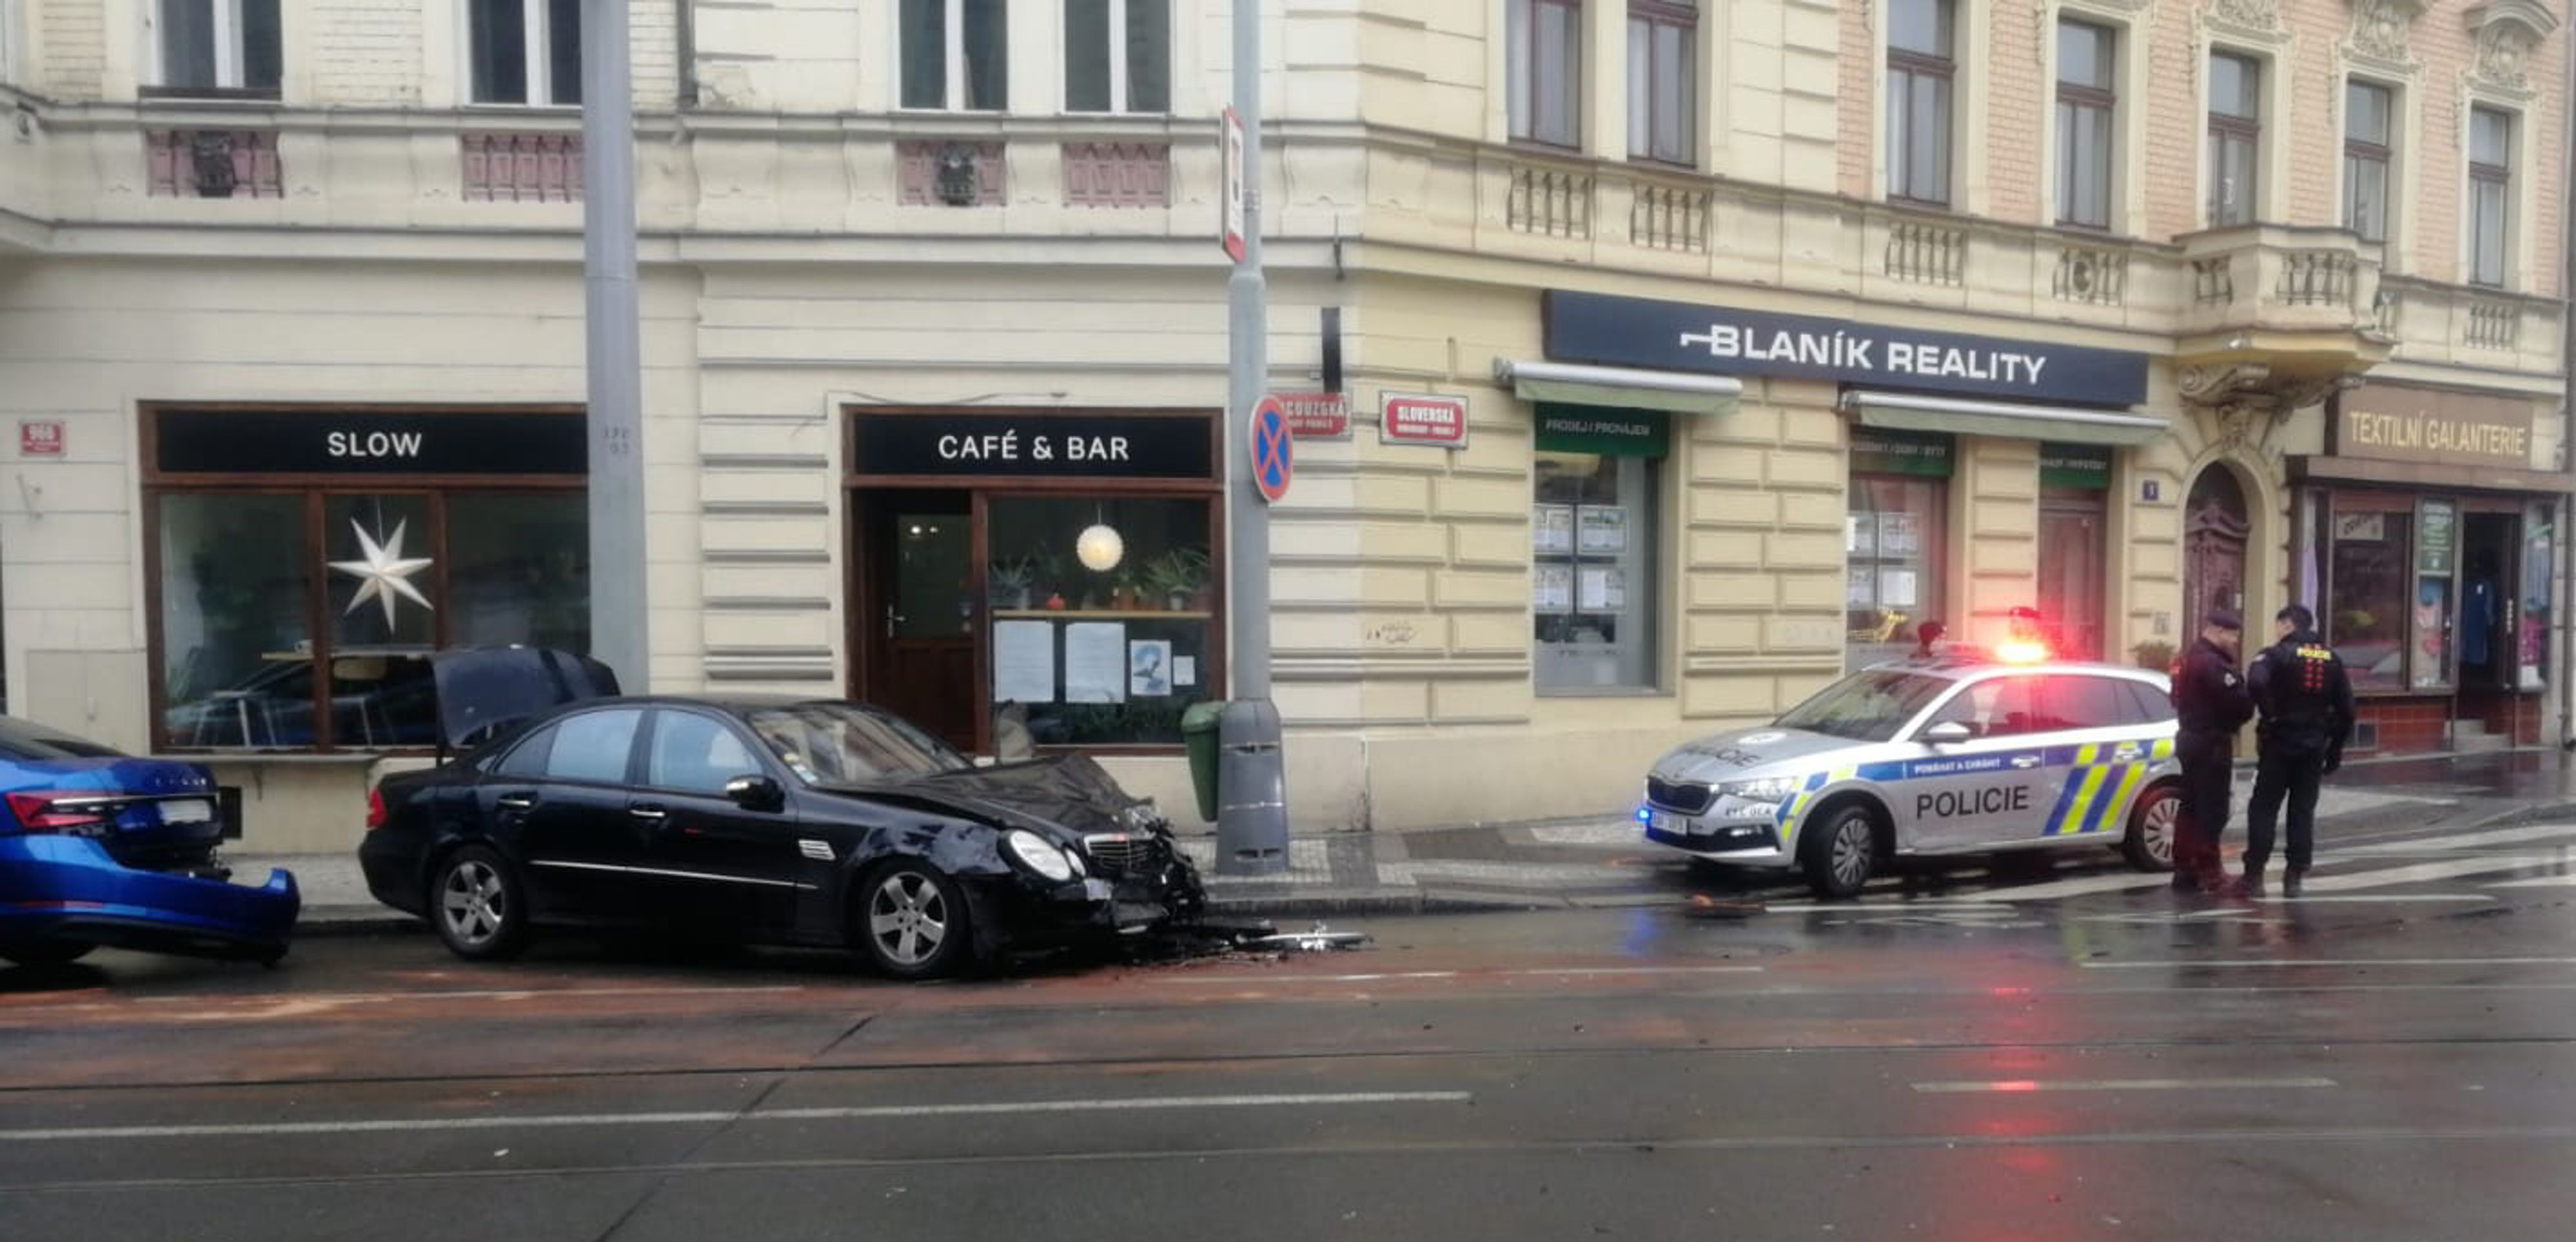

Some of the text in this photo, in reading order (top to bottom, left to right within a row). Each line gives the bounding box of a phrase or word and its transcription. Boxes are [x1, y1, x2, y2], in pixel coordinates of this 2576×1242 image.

[1710, 323, 2047, 384] BLANÍK REALITY
[1397, 405, 1455, 424] SLOVENSKÁ
[327, 431, 422, 457] SLOW
[938, 428, 1130, 461] CAFÉ & BAR
[2350, 409, 2526, 455] TEXTILNÍ GALANTERIE
[1916, 786, 2029, 820] POLICIE
